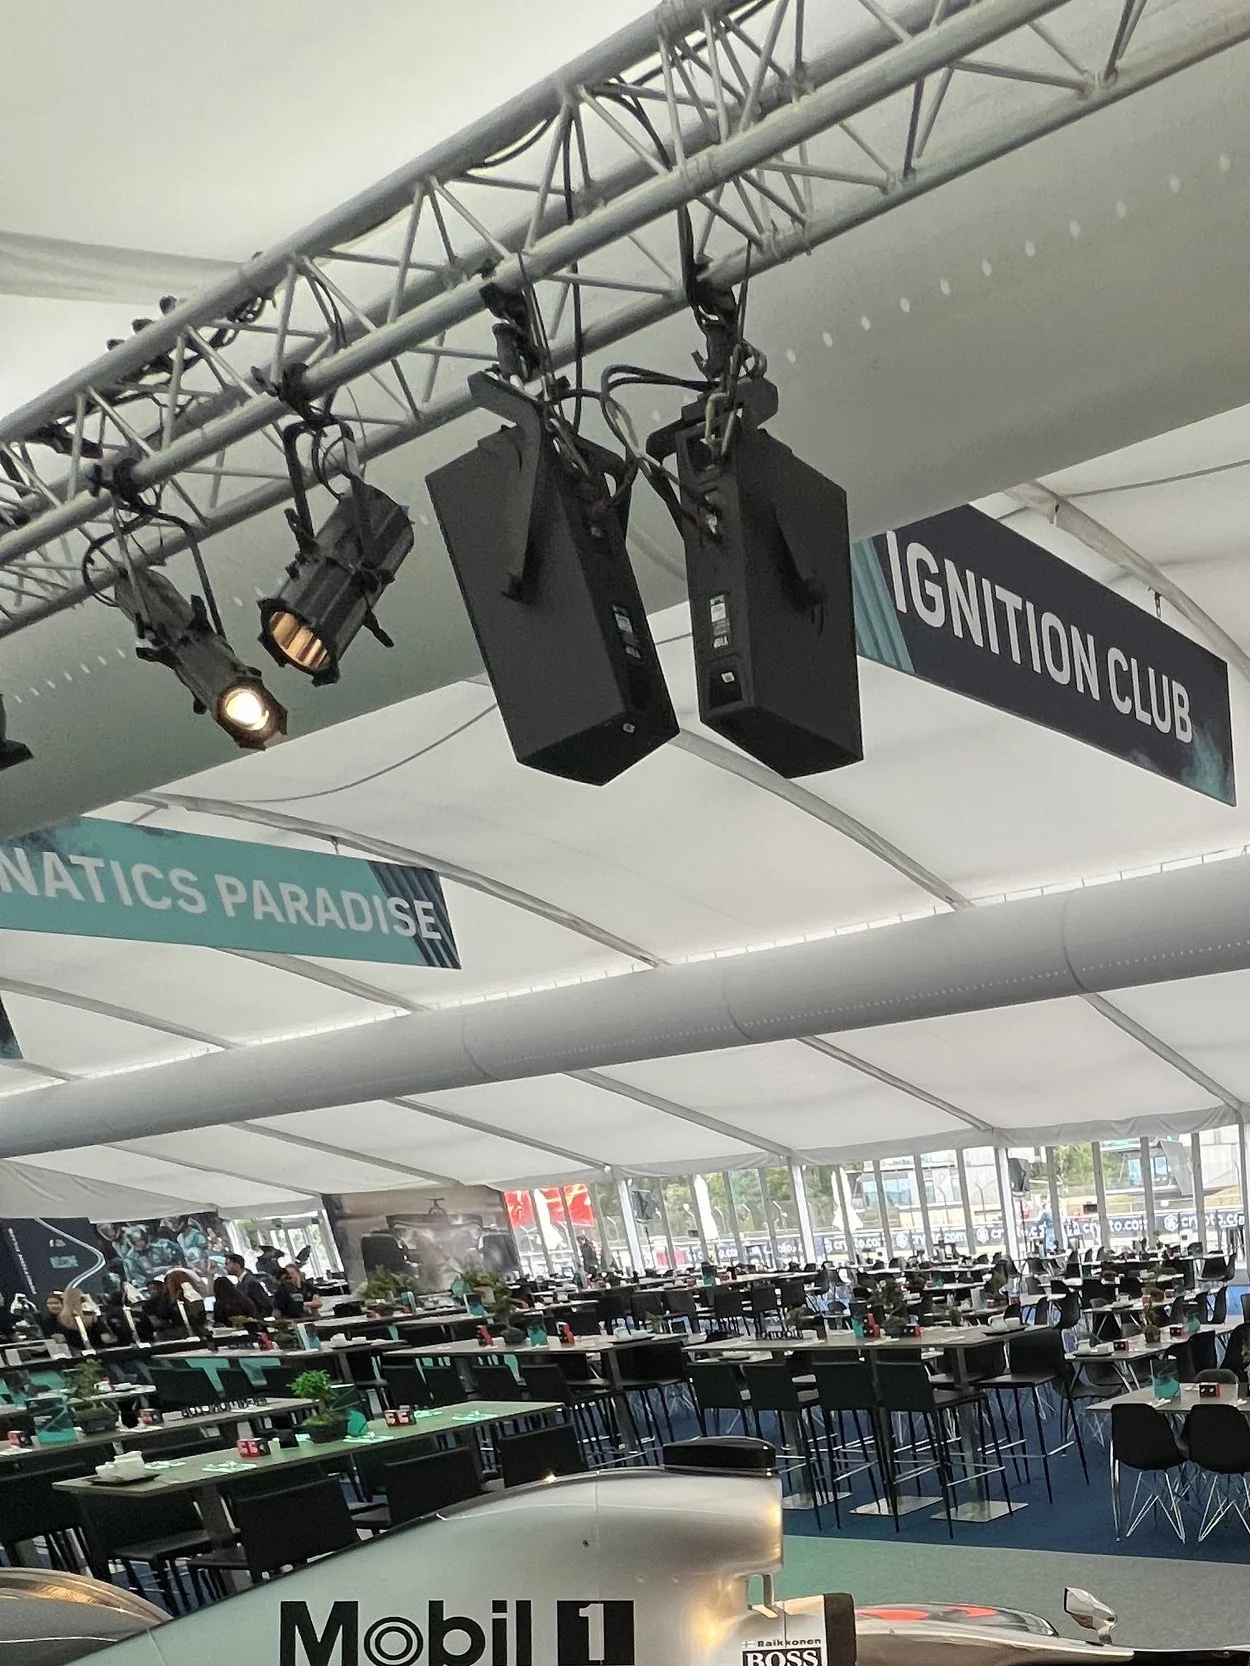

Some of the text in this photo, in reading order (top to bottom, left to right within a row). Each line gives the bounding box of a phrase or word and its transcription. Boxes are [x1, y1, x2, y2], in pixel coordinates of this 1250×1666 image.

[886, 530, 1192, 742] IGNITION CLUB
[215, 874, 441, 940] PARADISE
